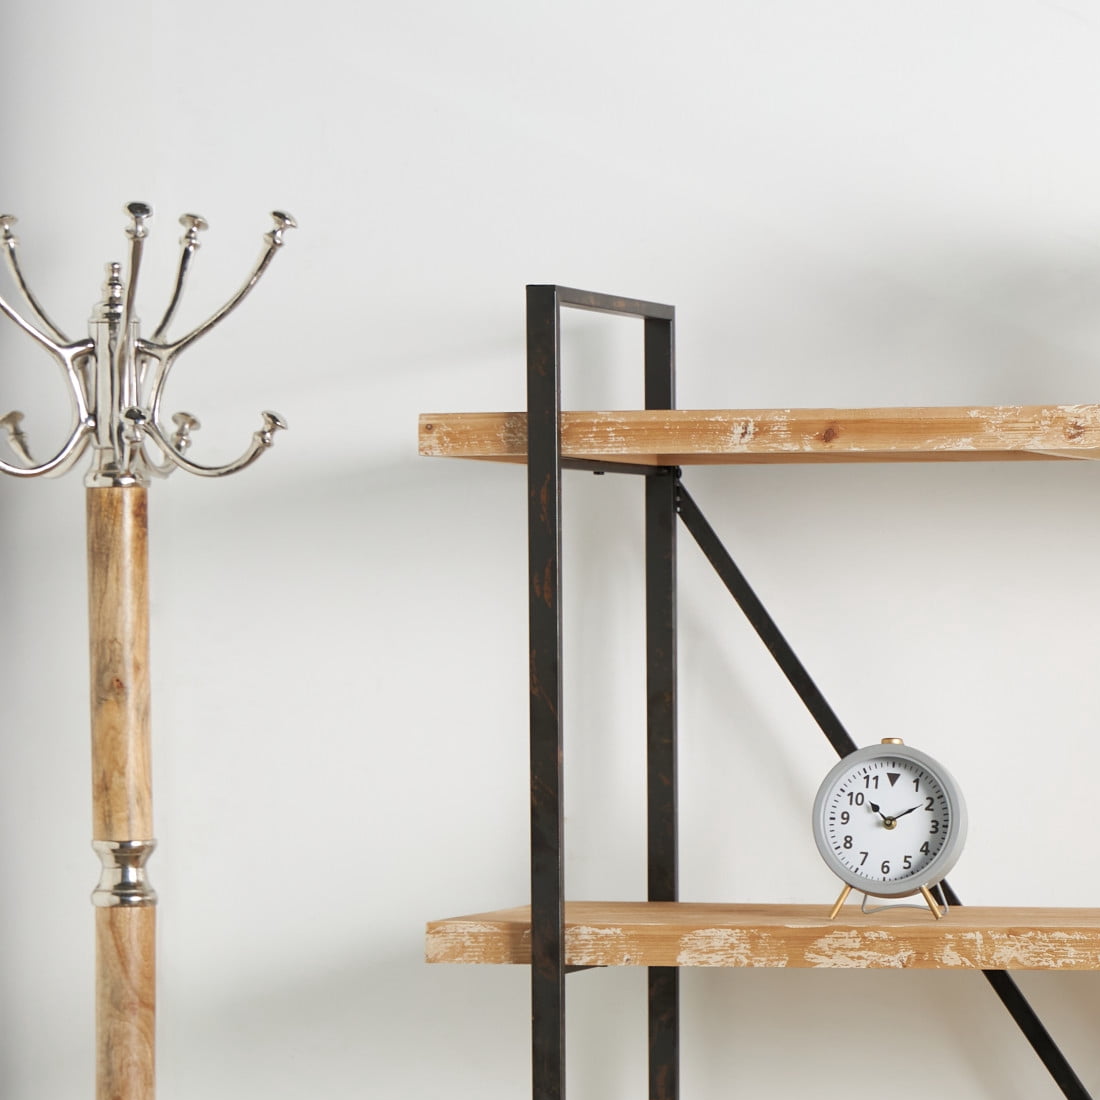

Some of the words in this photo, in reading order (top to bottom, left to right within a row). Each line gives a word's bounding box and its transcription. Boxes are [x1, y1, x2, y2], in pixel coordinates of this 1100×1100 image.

[863, 775, 879, 789] 11
[912, 778, 920, 792] 1
[847, 792, 865, 806] 10
[925, 797, 934, 811] 2
[841, 811, 850, 825] 9
[929, 820, 939, 834] 3
[843, 835, 853, 849] 8
[920, 841, 930, 855] 4
[859, 852, 869, 866] 7
[903, 856, 912, 869] 5
[881, 860, 890, 874] 6
